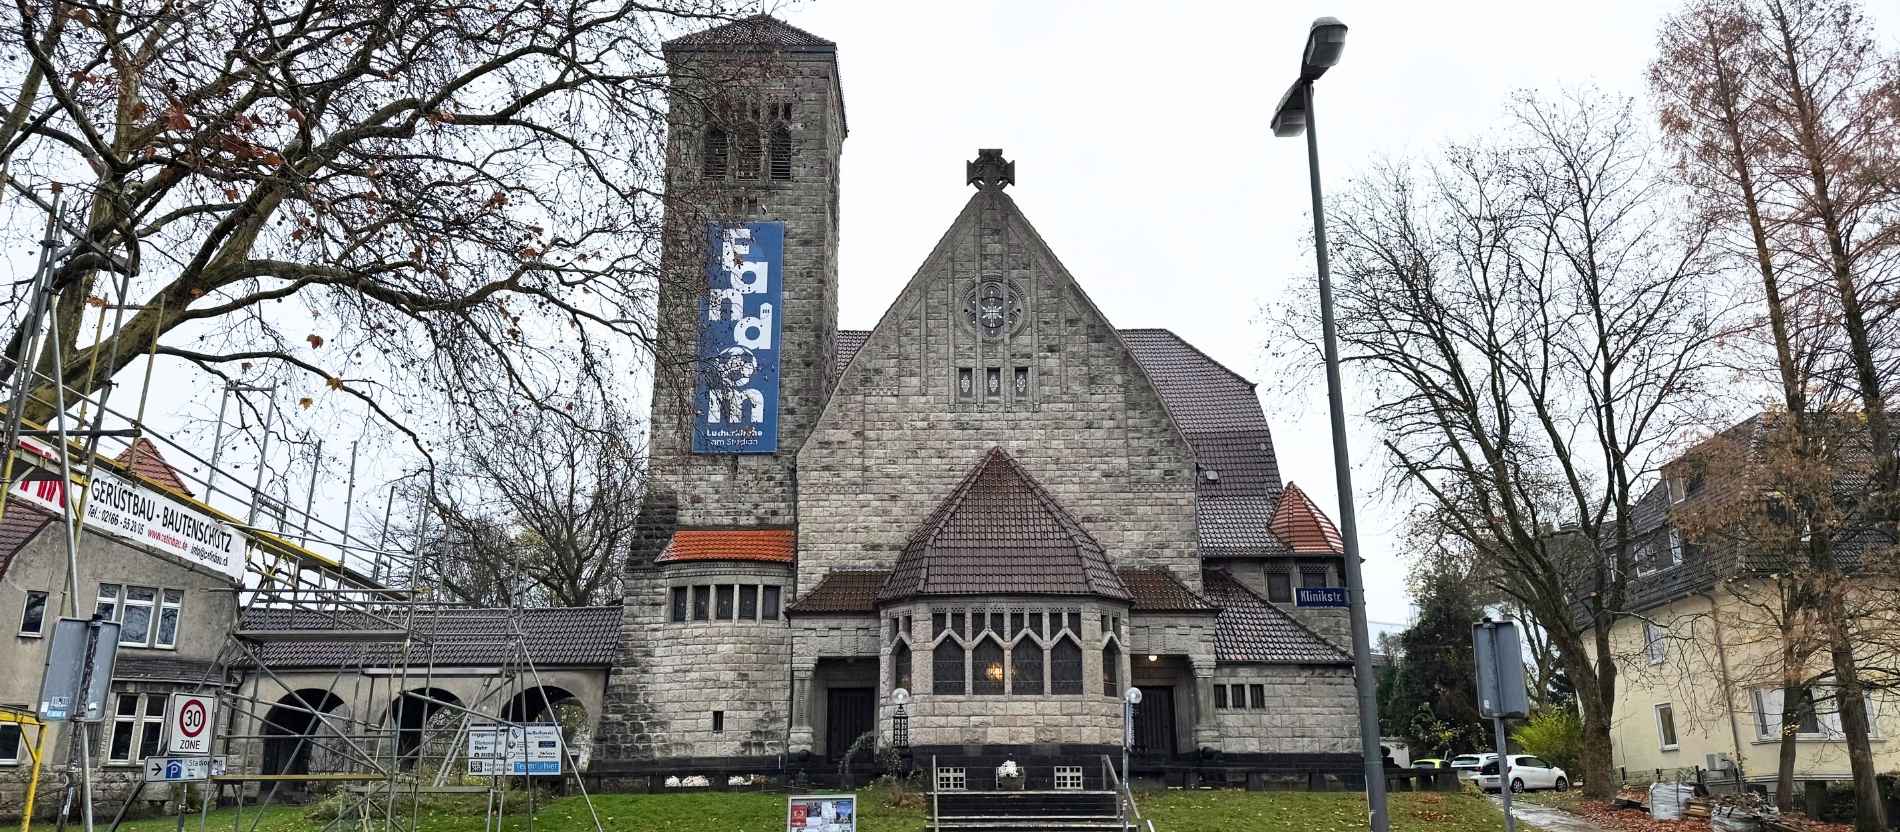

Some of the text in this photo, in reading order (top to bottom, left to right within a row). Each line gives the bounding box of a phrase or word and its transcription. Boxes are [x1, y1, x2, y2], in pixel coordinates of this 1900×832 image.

[91, 477, 156, 522] GERÜSTBAU
[1300, 590, 1344, 602] Klinikstr.
[185, 709, 201, 727] 30
[179, 739, 200, 750] ZONE
